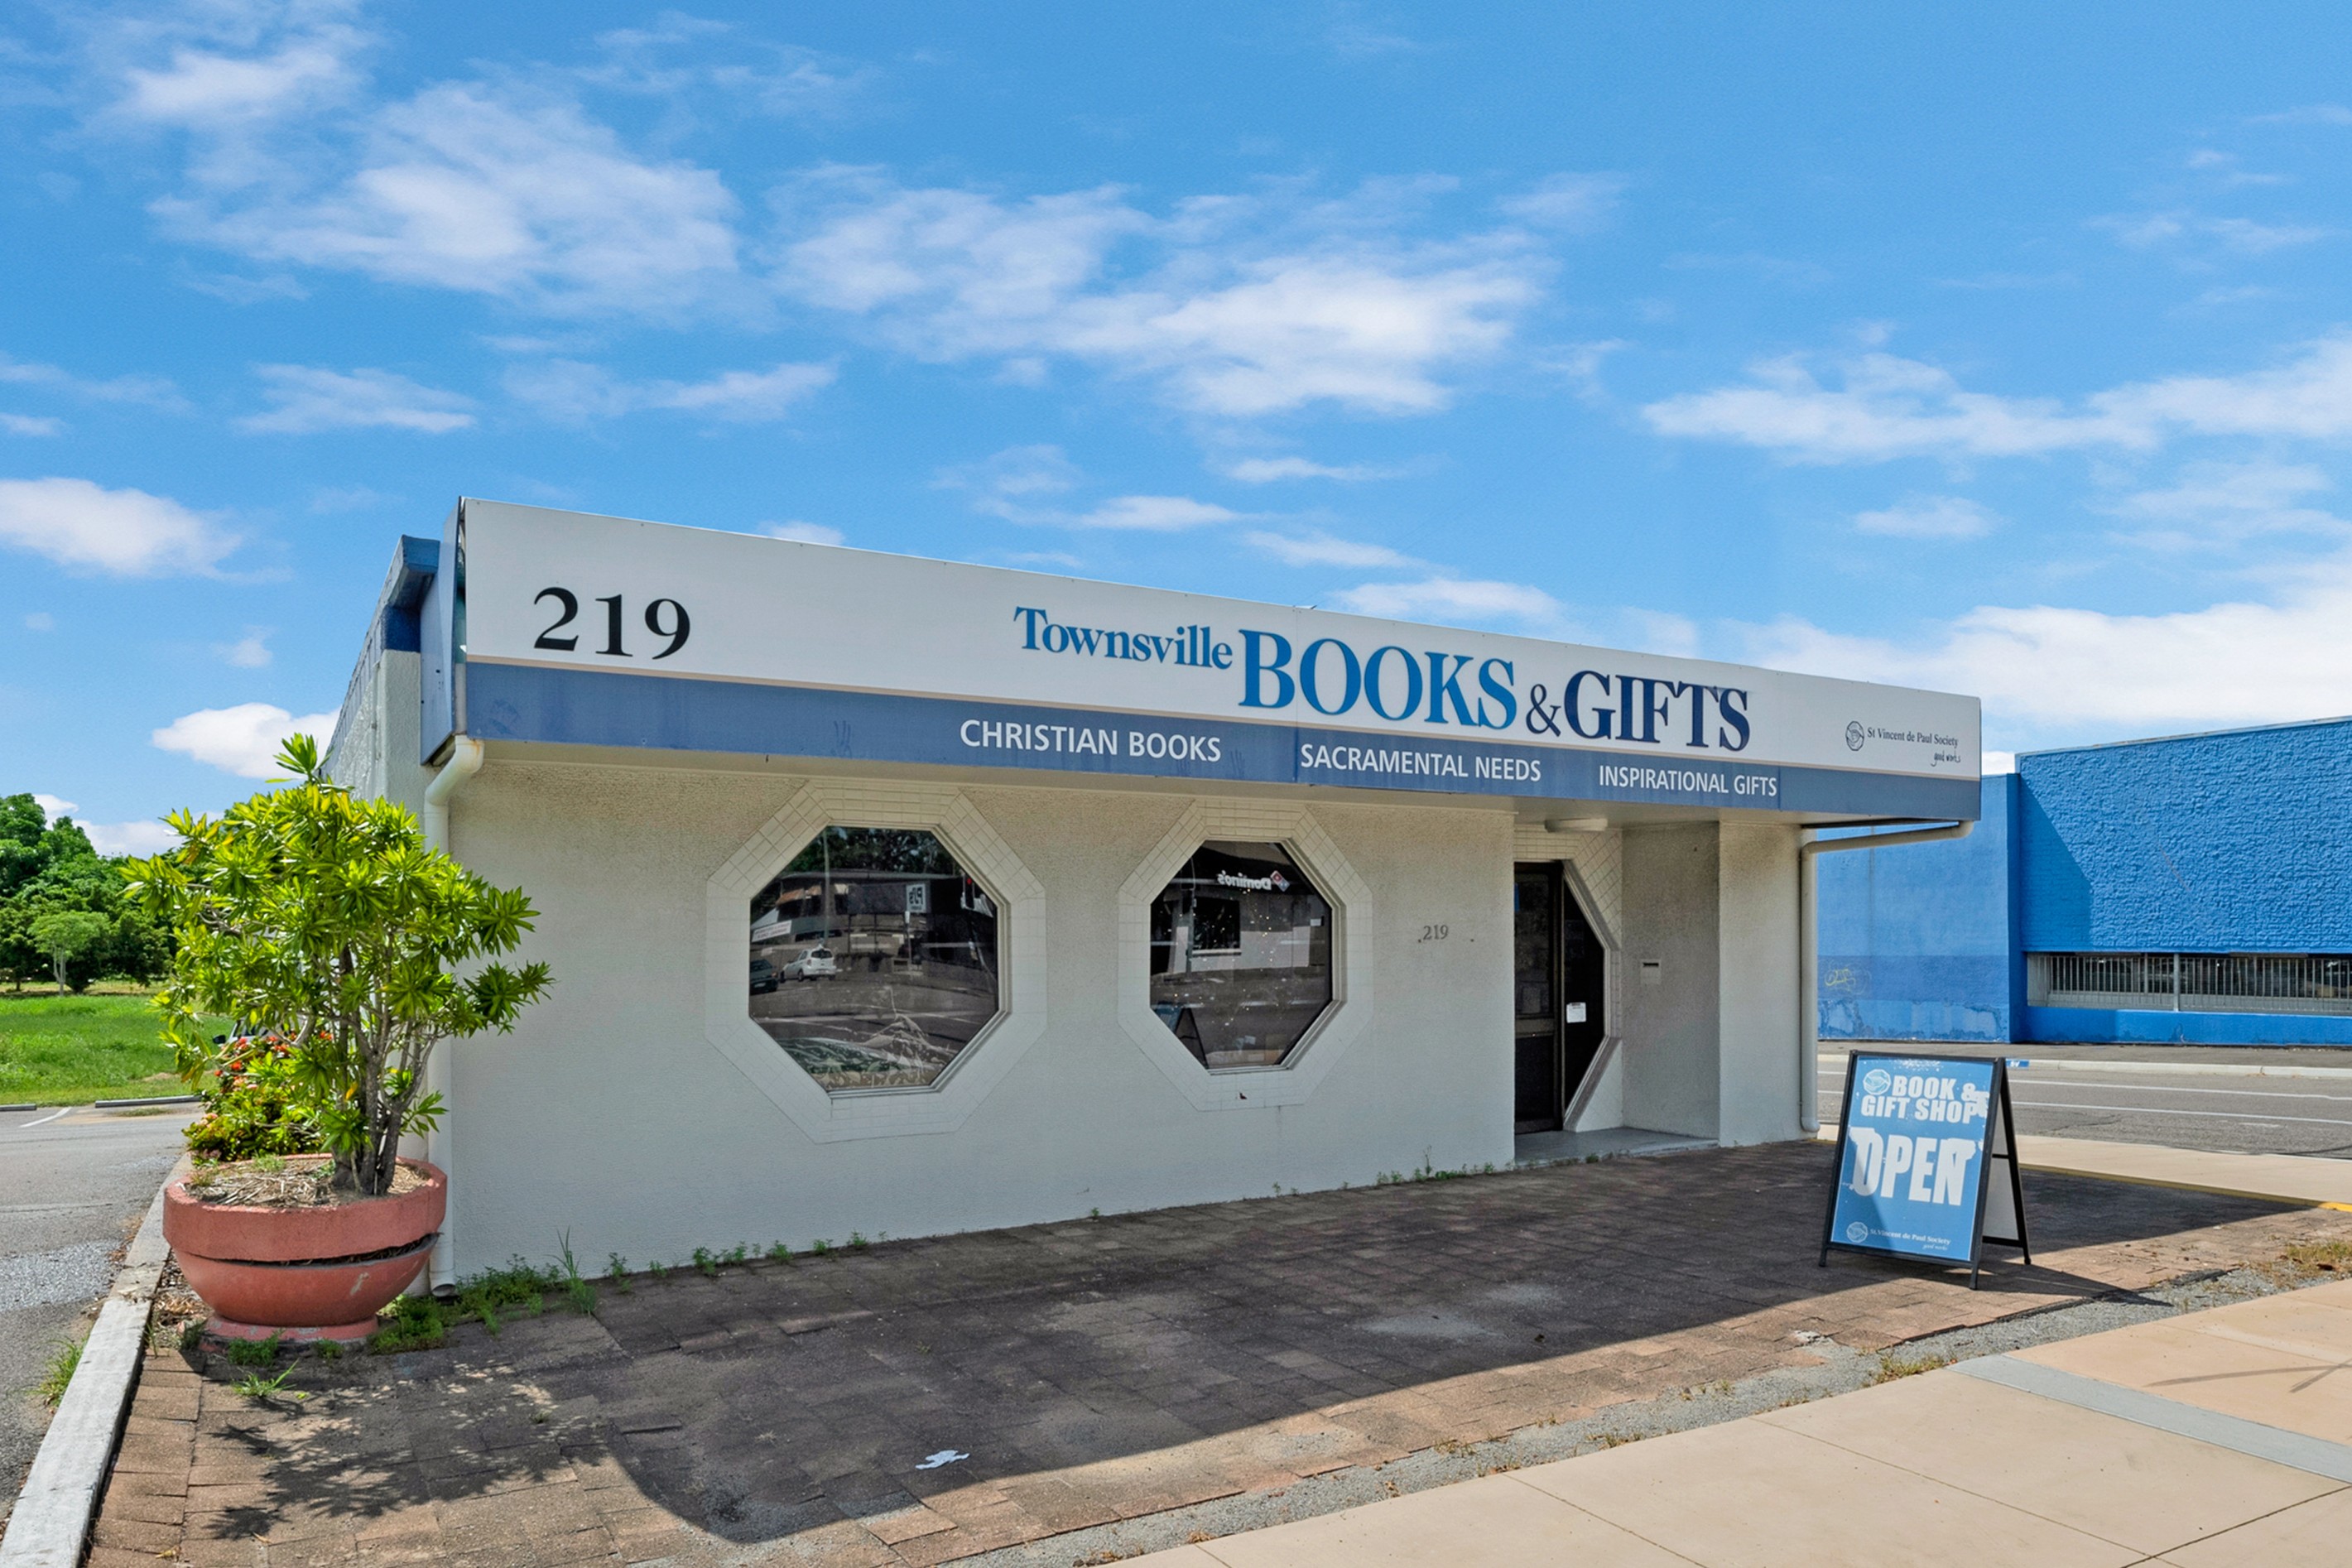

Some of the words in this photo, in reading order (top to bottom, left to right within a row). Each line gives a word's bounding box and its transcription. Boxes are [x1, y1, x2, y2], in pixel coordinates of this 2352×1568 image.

[534, 586, 690, 660] 219
[1013, 606, 1233, 670] Townsville
[1238, 629, 1517, 730] BOOKS
[960, 719, 1118, 756] CHRISTIAN
[1128, 731, 1222, 762] BOOKS
[1867, 727, 1875, 738] St
[1878, 729, 1905, 741] Vincent
[1907, 731, 1915, 743] de
[1917, 732, 1932, 744] Paul
[1934, 735, 1959, 748] Society
[1300, 743, 1469, 778] SACRAMENTAL
[1474, 756, 1542, 782] NEEDS
[1931, 750, 1945, 767] good
[1599, 765, 1729, 794] INSPIRATIONAL
[1734, 775, 1777, 796] GIFTS
[1422, 925, 1449, 940] 219
[1892, 1075, 1957, 1100] BOOK
[1861, 1094, 1911, 1118] GIFT
[1914, 1098, 1978, 1124] SHOP
[1851, 1130, 1974, 1206] OPEN
[1927, 1235, 1952, 1245] Society
